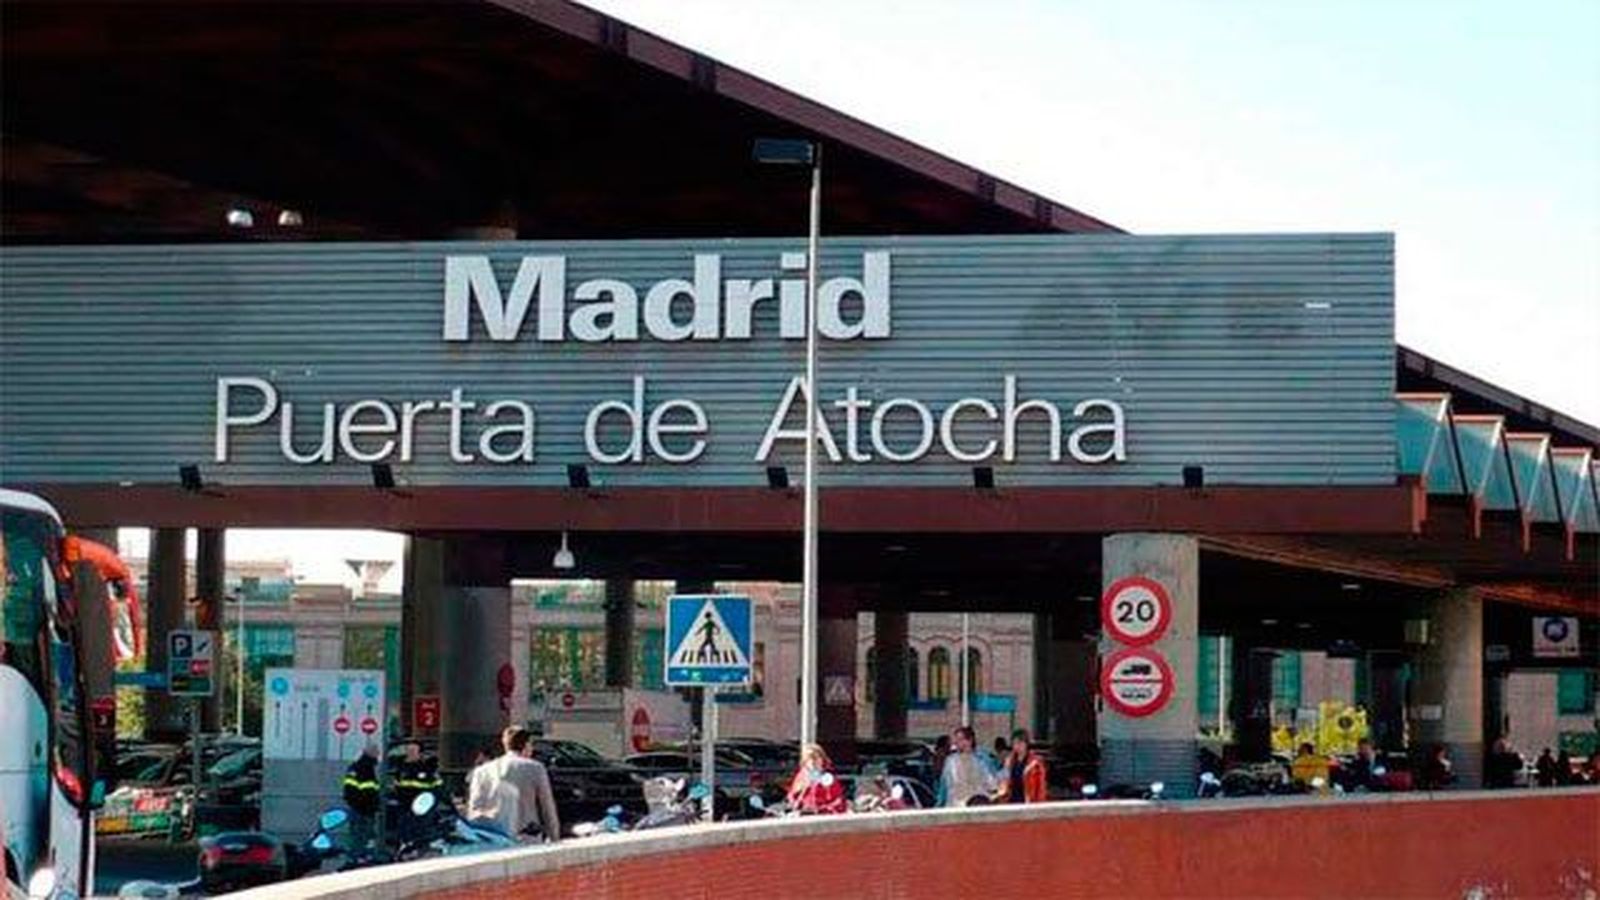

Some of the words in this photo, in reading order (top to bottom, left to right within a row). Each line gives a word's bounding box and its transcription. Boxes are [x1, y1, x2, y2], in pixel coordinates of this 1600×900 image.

[443, 251, 891, 342] Madrid
[214, 376, 534, 463] Puerta
[584, 374, 708, 463] de
[755, 374, 1127, 463] Atocha
[1116, 600, 1156, 623] 20
[174, 636, 189, 656] P
